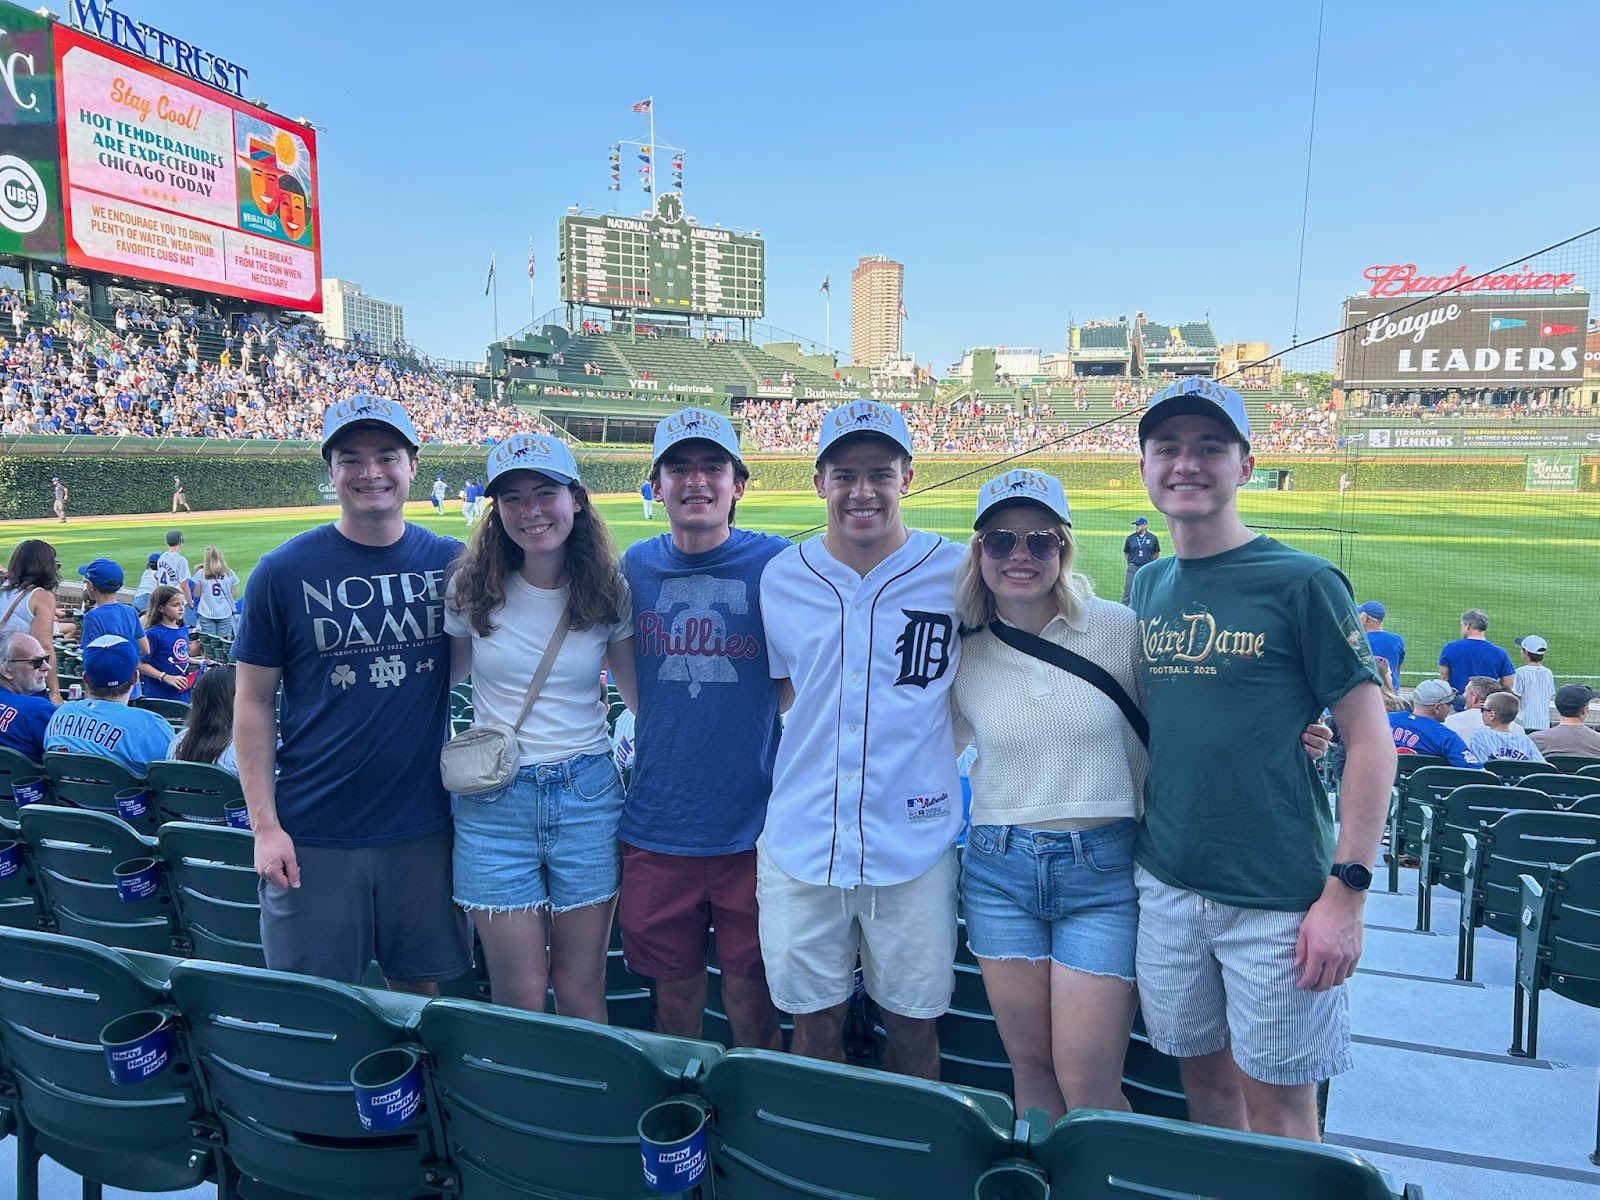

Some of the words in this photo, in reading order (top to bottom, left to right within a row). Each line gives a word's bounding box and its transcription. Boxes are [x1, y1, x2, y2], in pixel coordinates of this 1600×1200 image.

[71, 0, 248, 97] WINTRUST
[110, 78, 152, 122] Stay
[157, 95, 202, 131] Cool!
[80, 108, 112, 131] HOT
[116, 120, 224, 169] TEMPERATURES
[93, 132, 125, 154] ARE
[129, 143, 198, 176] EXPECTED
[202, 167, 215, 182] IN
[98, 152, 165, 183] CHICAGO
[168, 172, 213, 197] TODAY
[92, 205, 106, 218] WE
[108, 209, 158, 231] ENCOURAGE
[159, 222, 176, 236] YOU
[177, 226, 188, 238] TO
[189, 229, 212, 245] DRINK
[243, 212, 263, 225] WRIGLEY
[263, 217, 276, 231] FIELD
[607, 218, 650, 232] NATIONAL
[91, 219, 125, 237] PLENTY
[126, 228, 138, 240] OF
[139, 231, 169, 248] WATER,
[171, 239, 193, 253] WEAR
[195, 244, 215, 258] YOUR
[691, 229, 730, 242] AMERICAN
[116, 240, 156, 258] FAVORITE
[157, 249, 178, 263] CUBS
[180, 255, 195, 267] HAT
[243, 245, 250, 255] &
[251, 247, 267, 258] TAKE
[268, 250, 293, 265] BREAKS
[235, 256, 254, 268] FROM
[255, 261, 268, 272] THE
[269, 264, 282, 275] SUN
[283, 267, 301, 279] WHEN
[252, 273, 288, 289] NECESSARY
[1363, 263, 1576, 297] Budweiser
[1361, 303, 1461, 347] League
[1398, 346, 1578, 373] LEADERS
[628, 379, 658, 390] YETI
[804, 387, 859, 399] Budweiser
[882, 390, 919, 399] Advocate
[1161, 378, 1227, 401] CUBS
[336, 396, 392, 417] CUBS
[835, 403, 892, 426] CUBS
[667, 411, 719, 432] CUBS
[496, 438, 550, 462] CUBS
[1394, 437, 1453, 447] JENKINS
[1534, 465, 1574, 474] DRAFT
[990, 471, 1048, 494] CUBS
[212, 584, 221, 596] 6
[302, 569, 444, 614] NOTRE
[313, 606, 443, 651] DAME
[637, 610, 760, 660] Phillies
[1139, 614, 1187, 662] Notre
[1172, 612, 1265, 662] Dame
[892, 608, 953, 689] D
[1149, 666, 1189, 674] FOOTBALL
[1194, 666, 1217, 674] 2025
[48, 714, 122, 750] IMANAGA
[113, 1048, 141, 1060] Hefty
[128, 1051, 156, 1068] Hefty
[144, 1054, 167, 1074] Hefty
[373, 1091, 400, 1104] Hefty
[387, 1095, 413, 1113] Hefty
[660, 1149, 689, 1162] Hefty
[676, 1153, 701, 1173] Hefty
